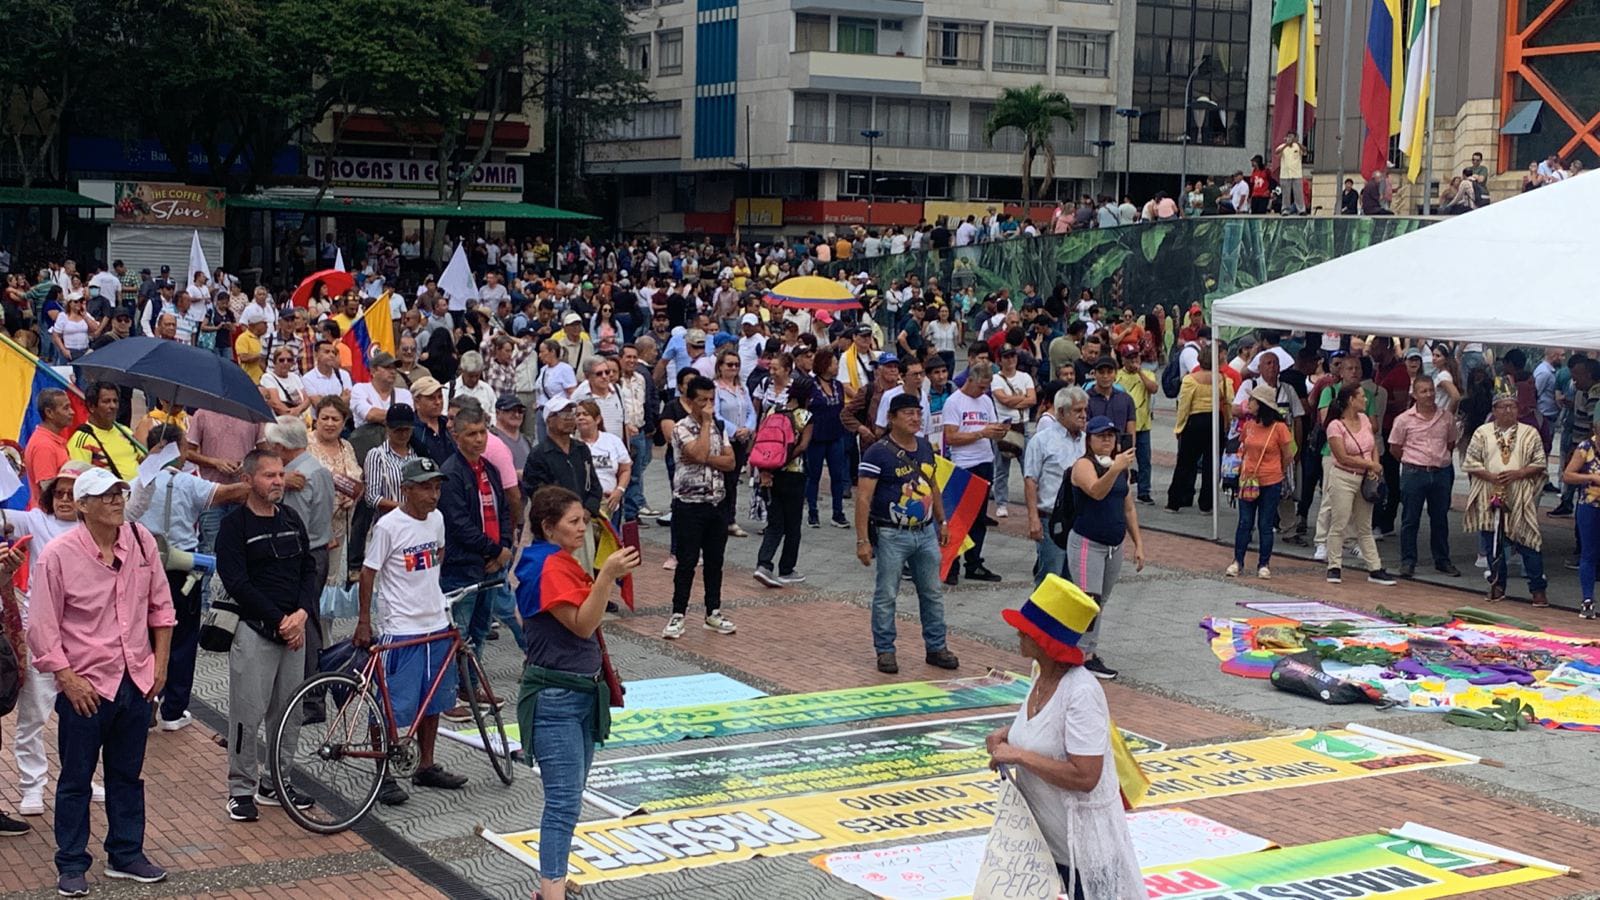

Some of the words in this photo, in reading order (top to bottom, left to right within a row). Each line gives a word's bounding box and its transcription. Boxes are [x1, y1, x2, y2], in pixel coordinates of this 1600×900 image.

[314, 159, 393, 180] DROGAS
[399, 163, 420, 181] LA
[151, 189, 167, 199] THE
[169, 189, 202, 202] COFFEE
[1192, 760, 1338, 788] SINDICATO
[958, 779, 1000, 794] EL
[984, 869, 1051, 900] PETRO
